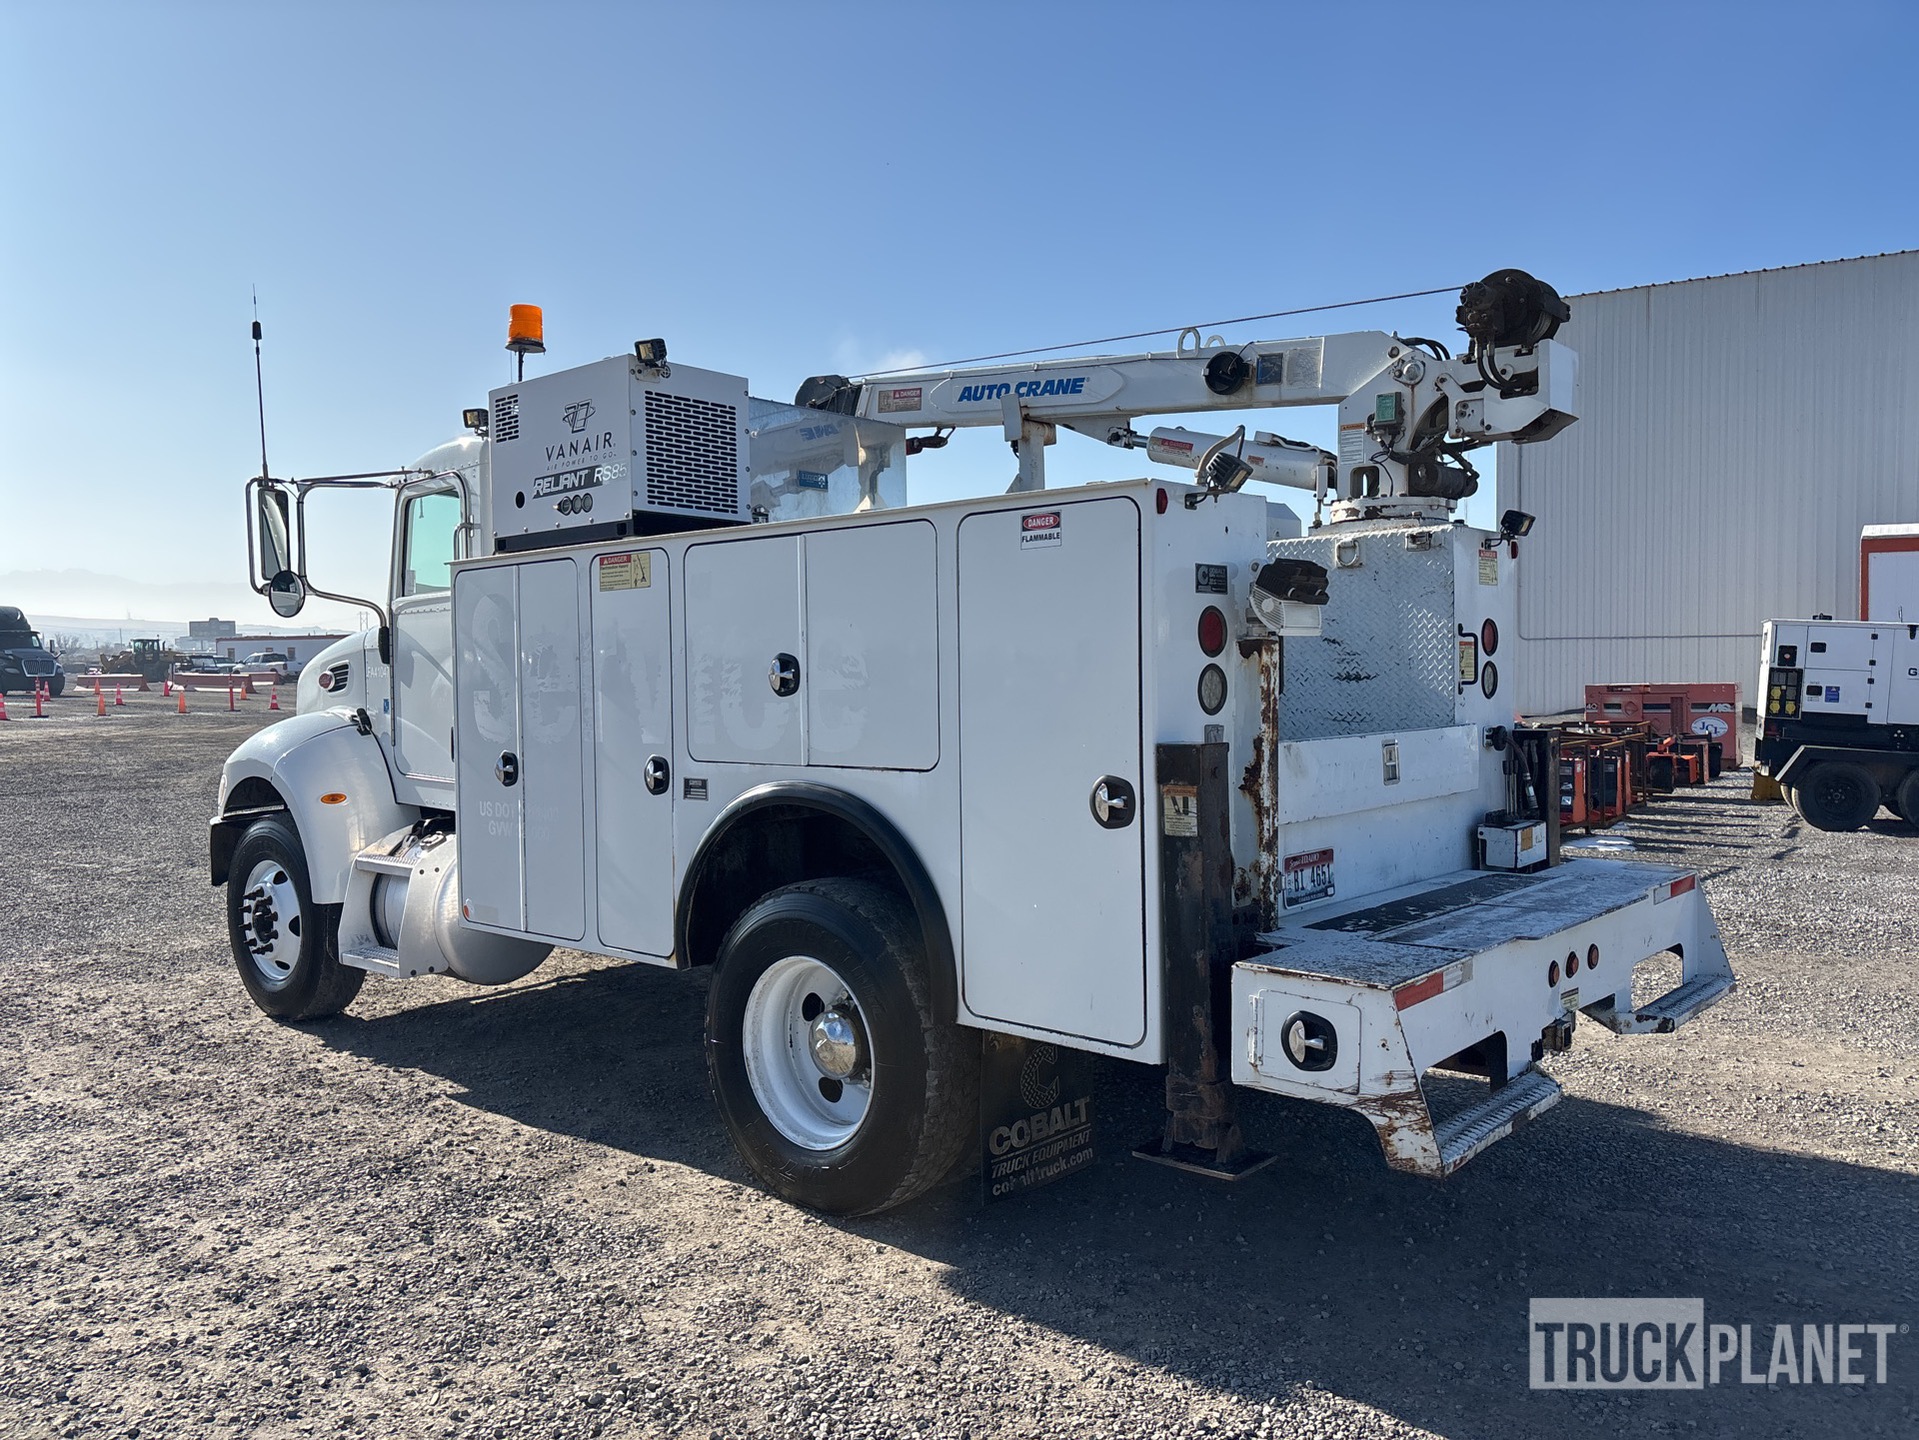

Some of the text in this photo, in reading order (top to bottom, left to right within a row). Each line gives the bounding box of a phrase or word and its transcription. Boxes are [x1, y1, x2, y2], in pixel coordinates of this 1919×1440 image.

[957, 377, 1086, 402] AUTO CRANE
[545, 431, 613, 462] VANAIR
[561, 457, 585, 468] POWER
[590, 454, 598, 462] TO
[534, 463, 628, 496] RELIANT RS85
[1028, 516, 1054, 528] DANGER
[1022, 532, 1060, 542] FLAMMABLE
[608, 555, 628, 563] DANGER
[479, 800, 493, 817] US
[1310, 862, 1332, 888] 4651
[988, 1096, 1090, 1156] COBALT
[991, 1128, 1093, 1179] TRUCK EQUIPMENT
